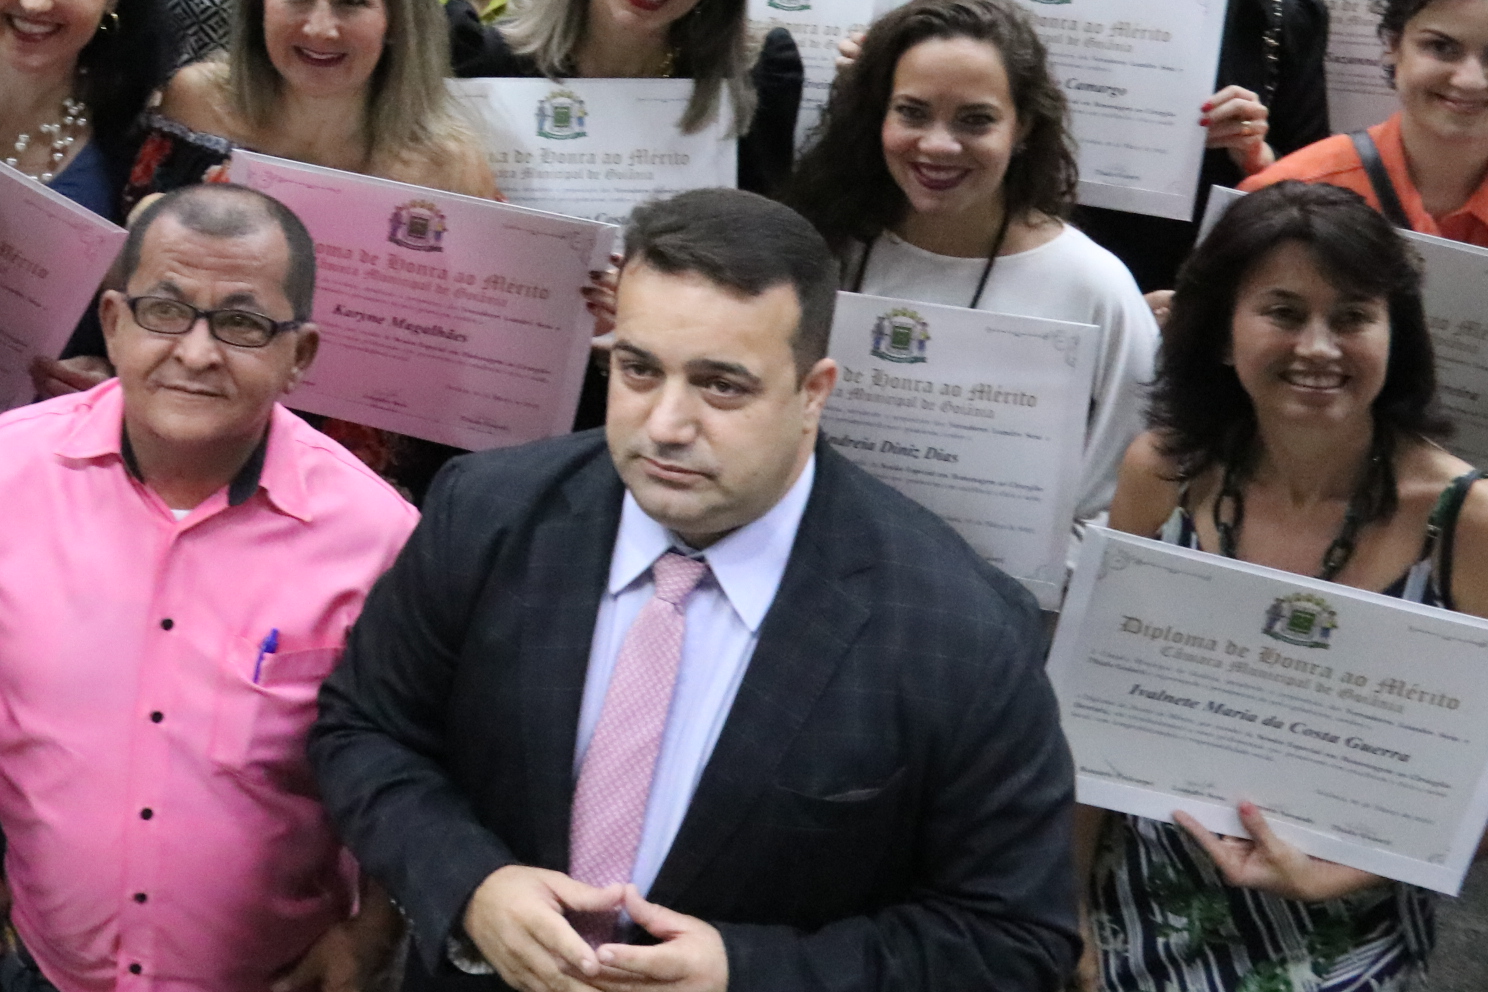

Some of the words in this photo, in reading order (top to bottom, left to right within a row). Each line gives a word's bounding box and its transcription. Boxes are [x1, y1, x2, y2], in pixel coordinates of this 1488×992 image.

[1065, 77, 1128, 99] Camargo
[358, 248, 380, 266] de
[388, 253, 449, 281] Honra
[453, 270, 476, 287] ao
[480, 272, 550, 301] Mérito
[842, 366, 864, 384] de
[871, 369, 934, 395] Honra
[939, 383, 963, 398] ao
[967, 382, 1039, 409] Mérito
[1118, 614, 1218, 652] Diploma
[1224, 638, 1251, 659] de
[1258, 646, 1333, 680] Honra
[1340, 671, 1369, 689] ao
[1373, 677, 1462, 711] Mérito
[1203, 700, 1259, 723] Maria
[1261, 715, 1285, 730] da
[1288, 722, 1341, 745] Costa
[1343, 736, 1412, 764] Guerra
